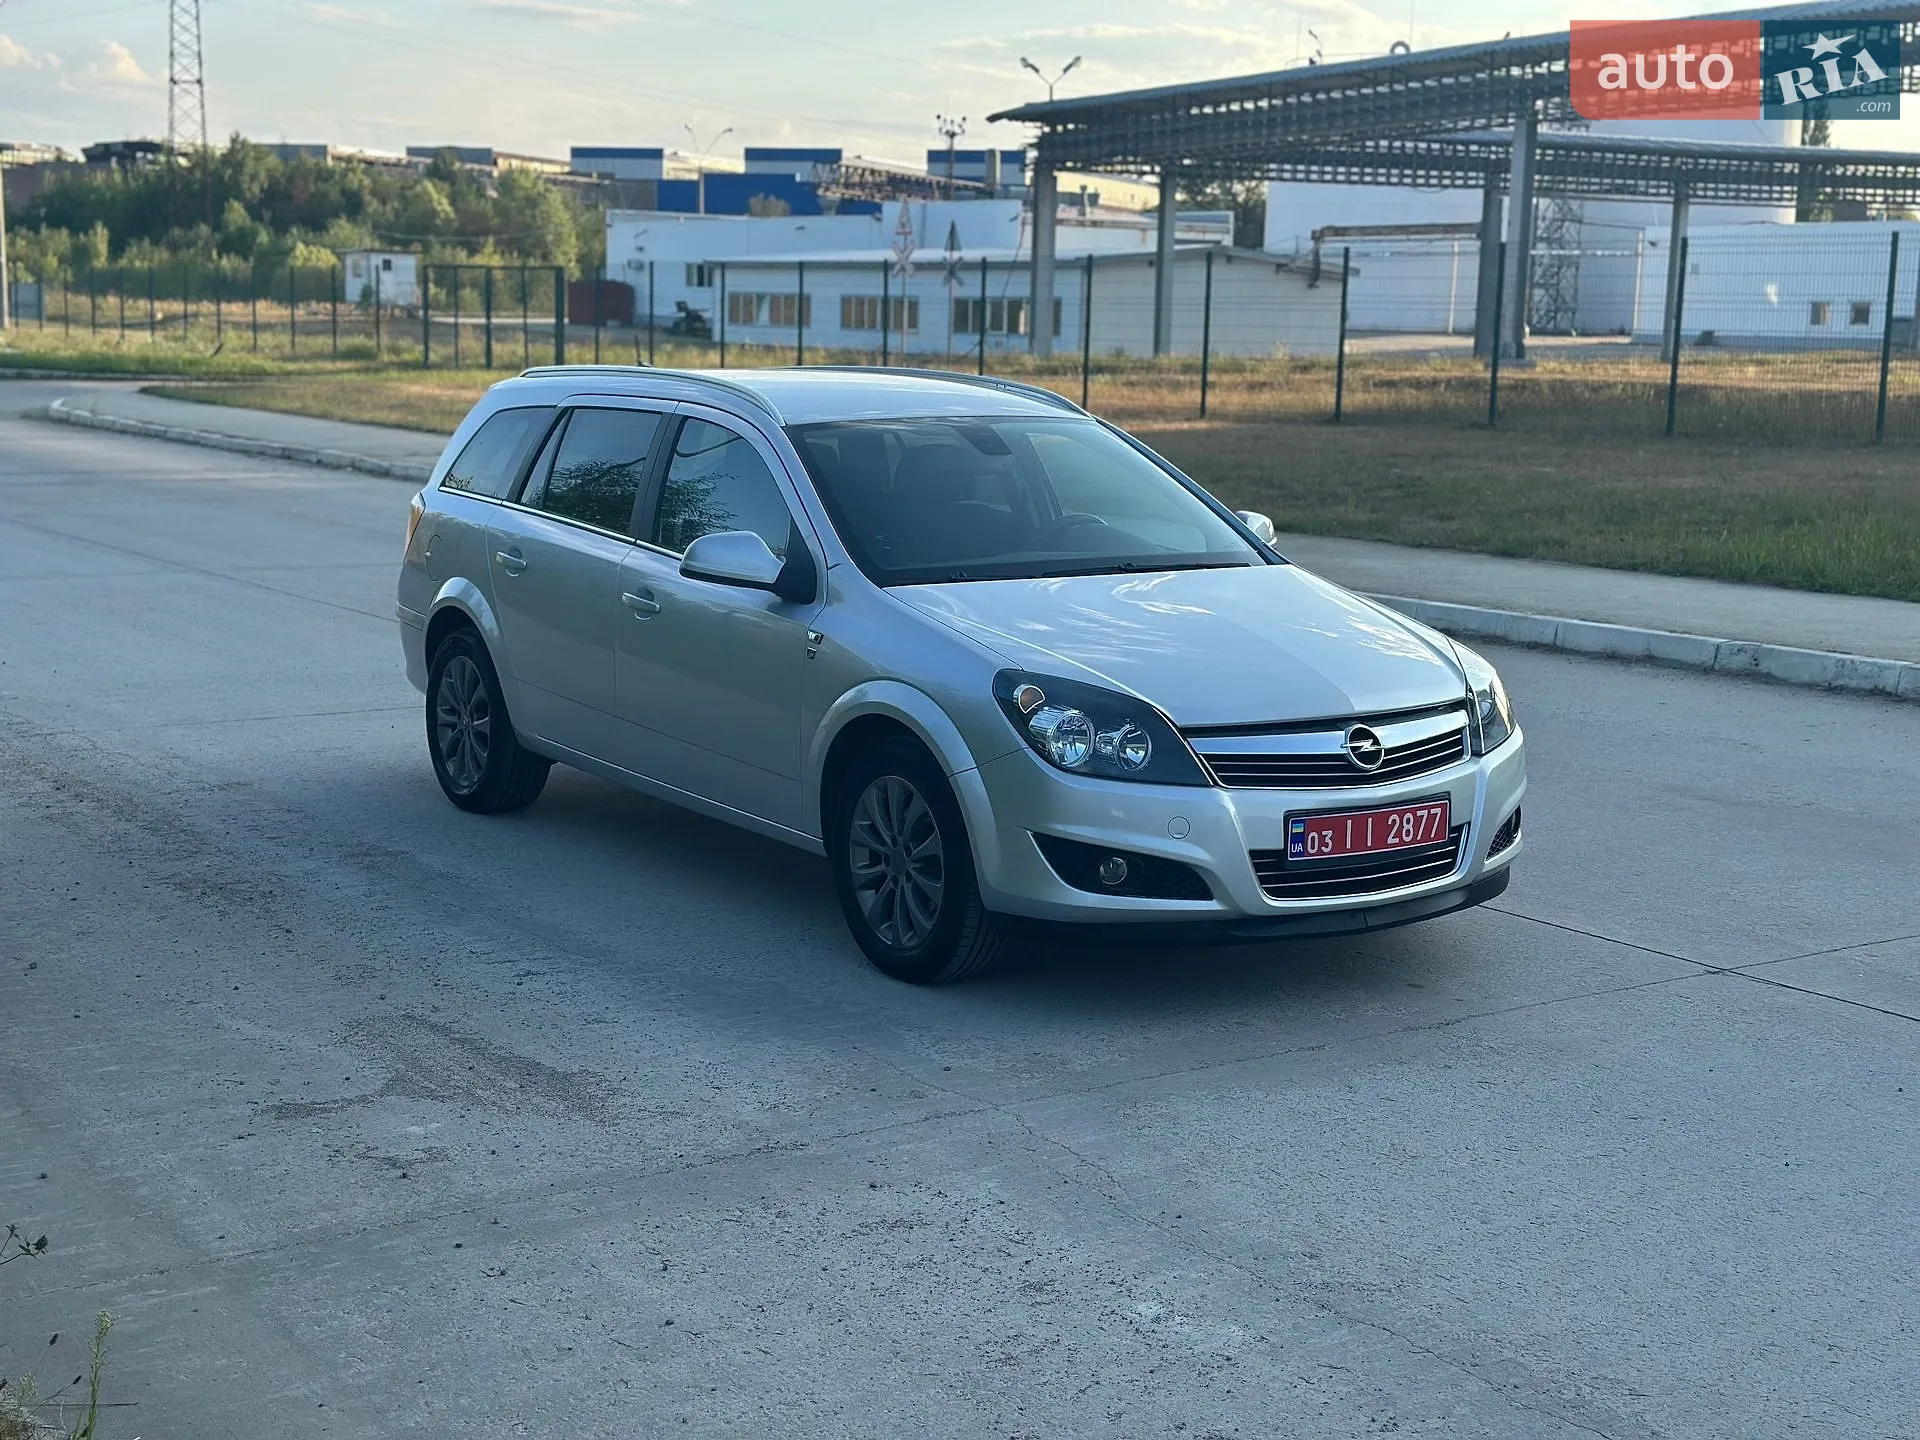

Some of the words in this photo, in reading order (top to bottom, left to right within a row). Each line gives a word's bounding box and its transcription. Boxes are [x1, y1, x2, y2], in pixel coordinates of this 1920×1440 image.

[1307, 830, 1333, 854] 03
[1387, 808, 1442, 845] 2877
[1291, 842, 1304, 853] UA
